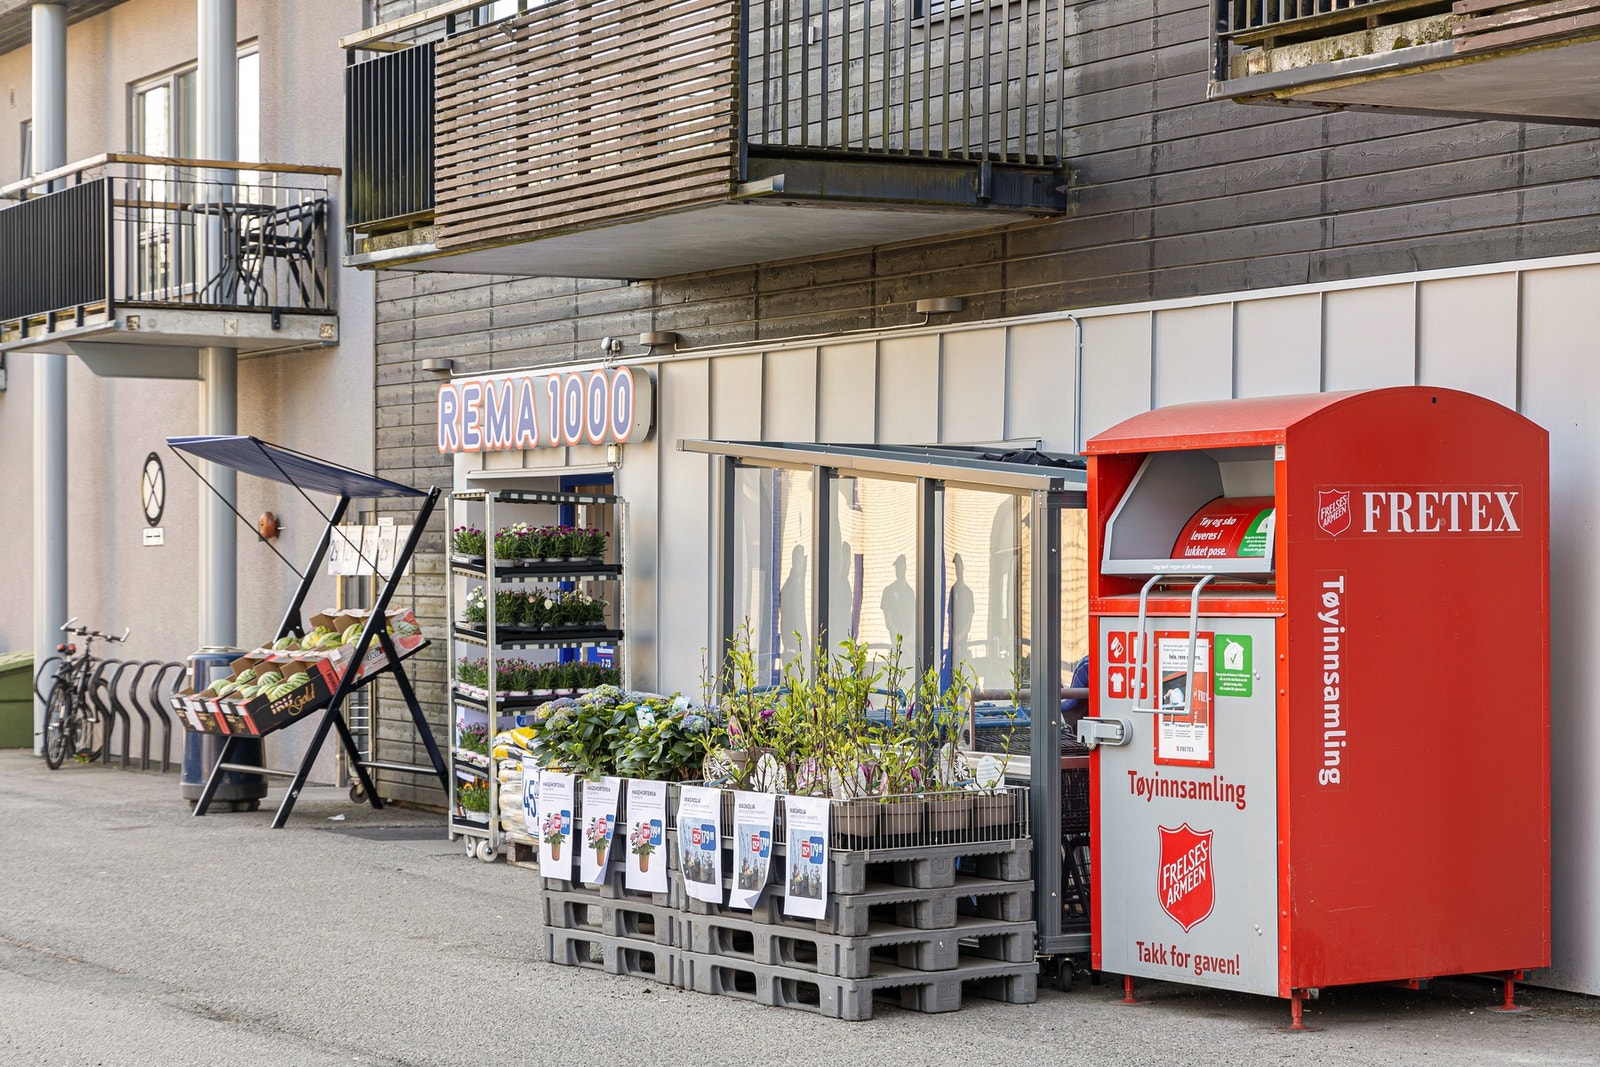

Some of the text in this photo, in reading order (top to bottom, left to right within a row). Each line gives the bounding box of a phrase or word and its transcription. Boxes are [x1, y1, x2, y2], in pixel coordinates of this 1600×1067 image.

[438, 366, 635, 454] REMA 1000
[1200, 516, 1237, 528] Tøy og sko
[1320, 494, 1349, 520] FRELSES-
[1322, 506, 1347, 528] ARMEEN
[1362, 491, 1520, 533] FRETEX
[1184, 545, 1227, 559] lukket pose.
[1190, 529, 1224, 540] leveres i
[1317, 575, 1347, 786] Tøyinnsamling
[523, 779, 537, 818] 45
[1127, 770, 1246, 810] Tøyinnsamling
[1163, 839, 1209, 891] FRELSES-
[1166, 862, 1206, 909] ARMEEN
[1136, 940, 1240, 976] Takk for gaven!
